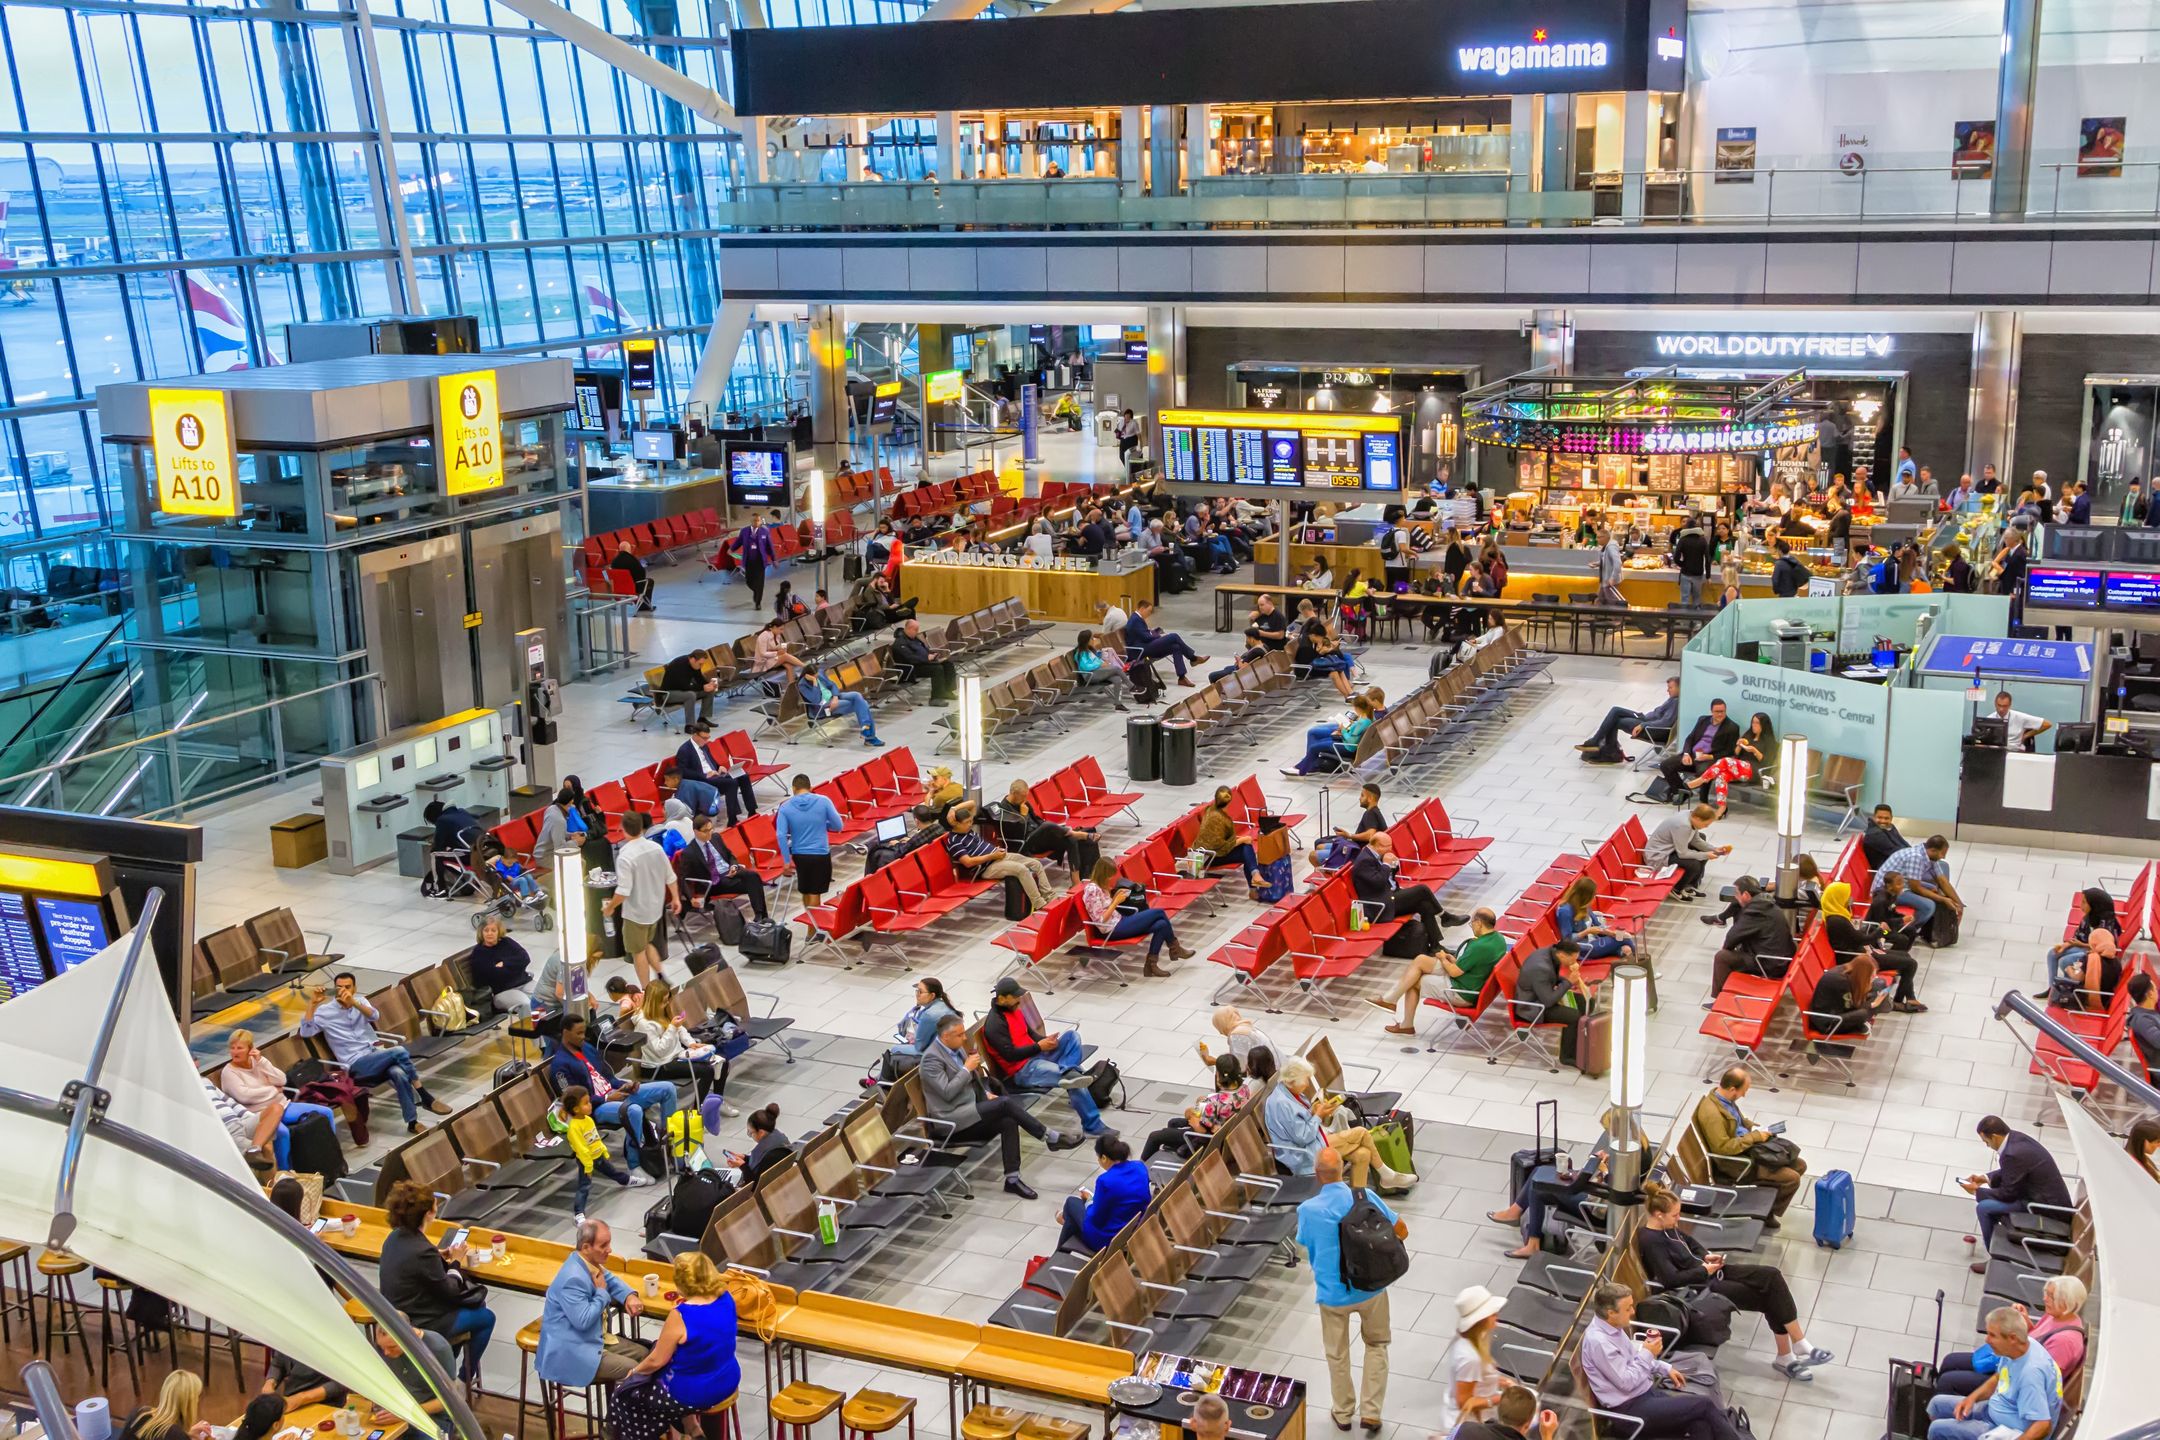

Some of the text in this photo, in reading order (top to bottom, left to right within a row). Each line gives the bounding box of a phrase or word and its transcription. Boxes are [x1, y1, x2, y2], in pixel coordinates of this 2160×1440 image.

[1459, 42, 1607, 76] wagamama
[1323, 372, 1374, 384] PRADA
[455, 426, 489, 441] Lifts to
[1644, 423, 1817, 450] STARBUCKS COFFEE
[171, 457, 216, 471] Lifts to
[455, 441, 492, 471] A10
[171, 475, 221, 501] A10
[1332, 476, 1359, 487] 05:59
[913, 549, 1088, 571] STARBUCKS COFFEE
[2030, 591, 2064, 599] management
[1742, 674, 1836, 702] BRITISH AIRWAYS
[1741, 689, 1787, 708] Customer
[1789, 699, 1829, 716] Services
[1838, 708, 1875, 725] Central
[50, 920, 95, 931] pre-order your
[60, 928, 90, 938] Heathrow
